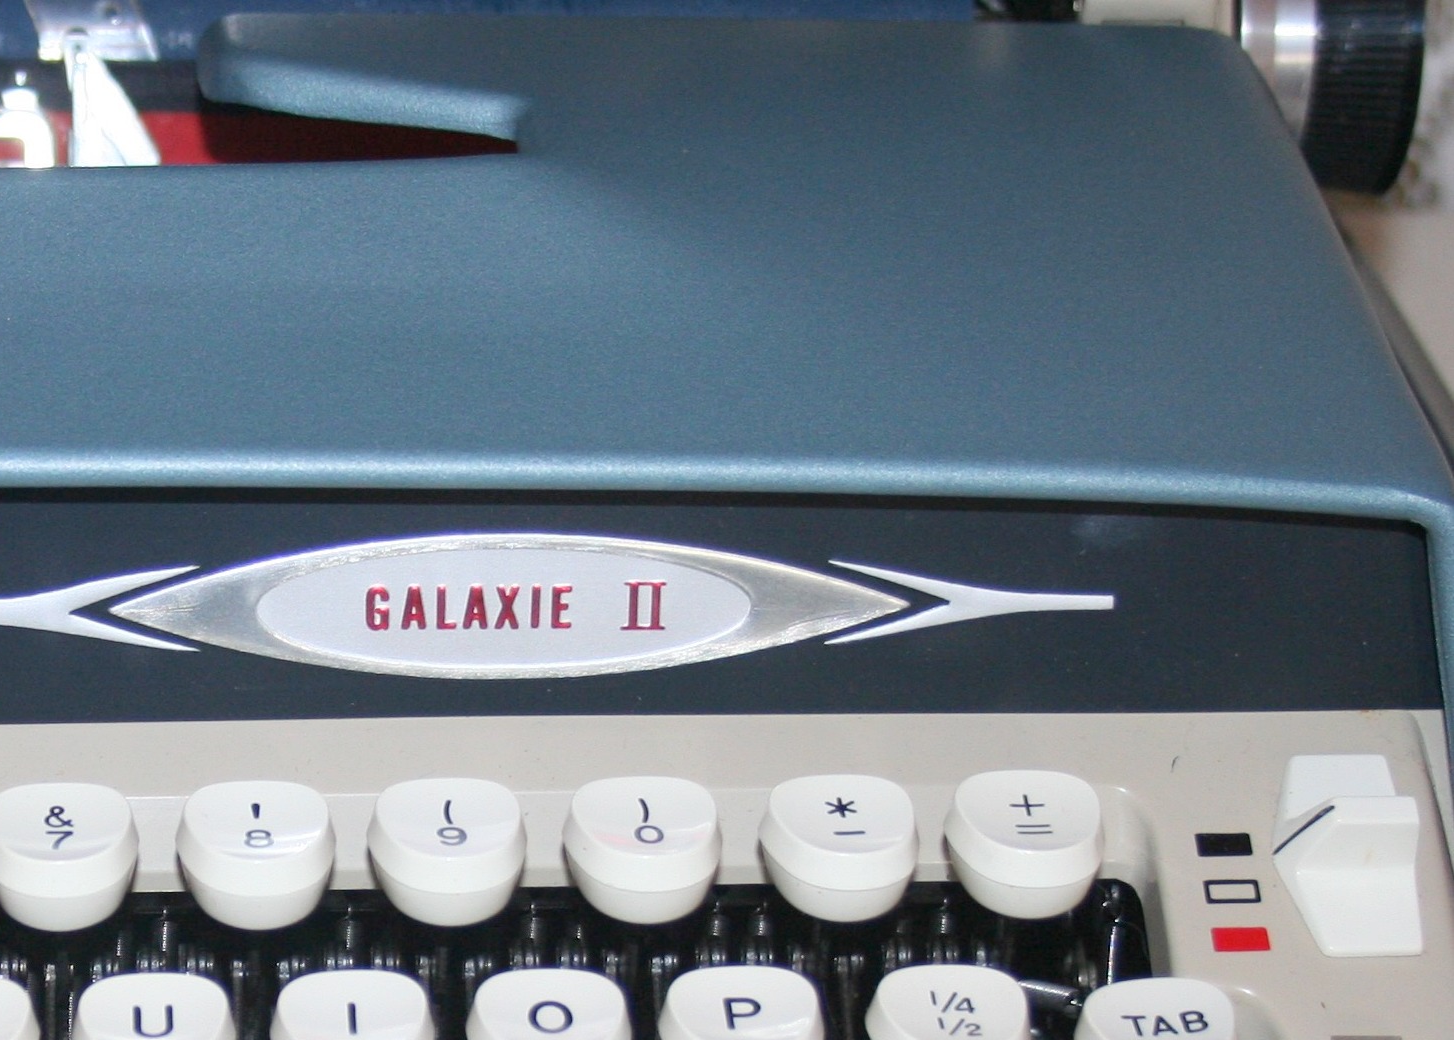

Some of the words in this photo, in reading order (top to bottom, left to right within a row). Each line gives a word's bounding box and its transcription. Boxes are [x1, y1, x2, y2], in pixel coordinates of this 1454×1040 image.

[365, 586, 573, 632] GALAXIE
[620, 581, 667, 631] II
[44, 805, 74, 828] &
[46, 830, 75, 850] 7
[244, 829, 272, 848] 8
[436, 825, 468, 846] 9
[133, 1004, 174, 1038] U
[347, 1002, 358, 1034] I
[528, 1000, 574, 1034] O
[723, 997, 762, 1030] P
[1122, 1010, 1209, 1037] TAB
